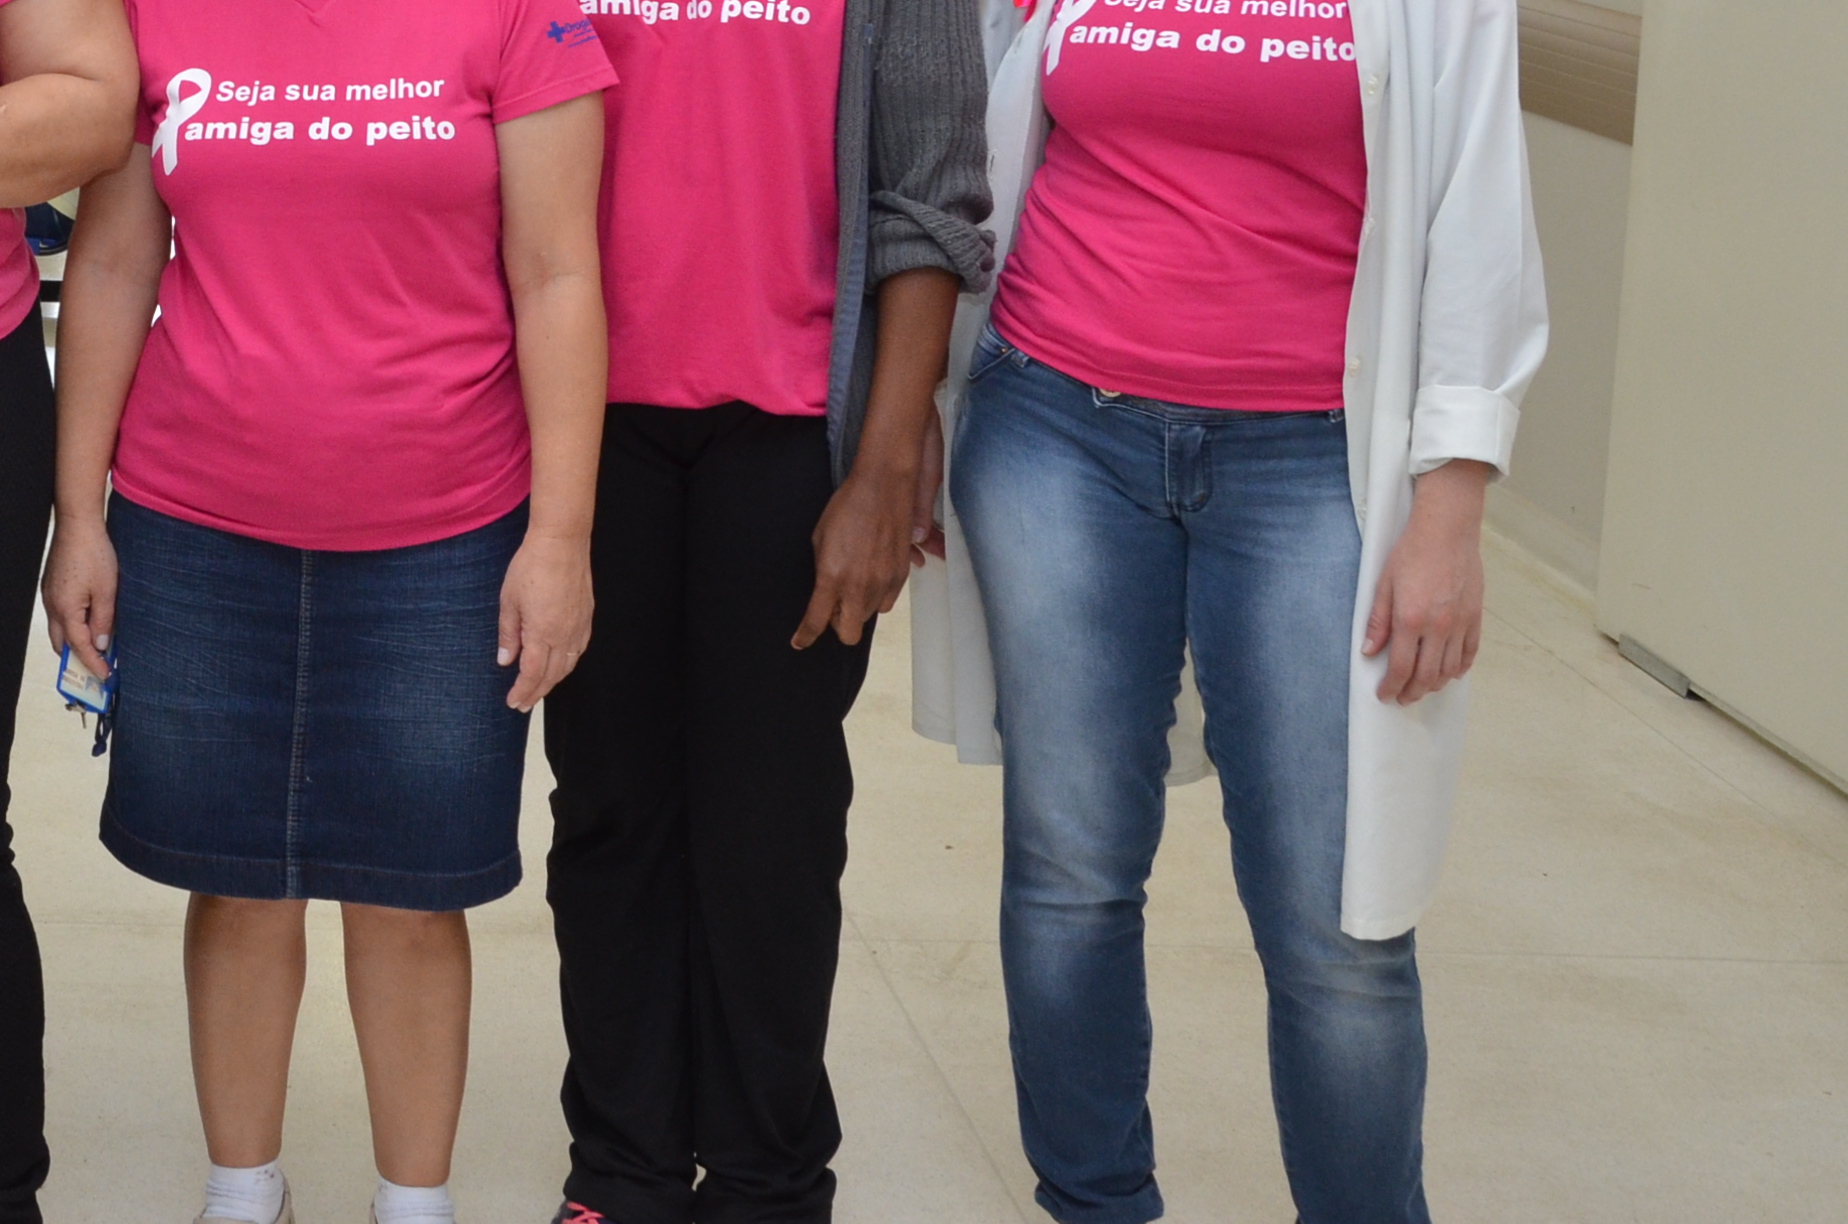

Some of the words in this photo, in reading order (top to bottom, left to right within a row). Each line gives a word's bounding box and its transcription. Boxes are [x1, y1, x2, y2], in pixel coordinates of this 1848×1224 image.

[1070, 23, 1180, 51] amiga
[1196, 29, 1245, 53] do
[1260, 36, 1356, 62] peito
[216, 81, 275, 106] Seja
[285, 85, 335, 100] sua
[346, 78, 444, 100] melhor
[184, 117, 294, 145] amiga
[309, 117, 352, 140] do
[367, 116, 455, 145] peito
